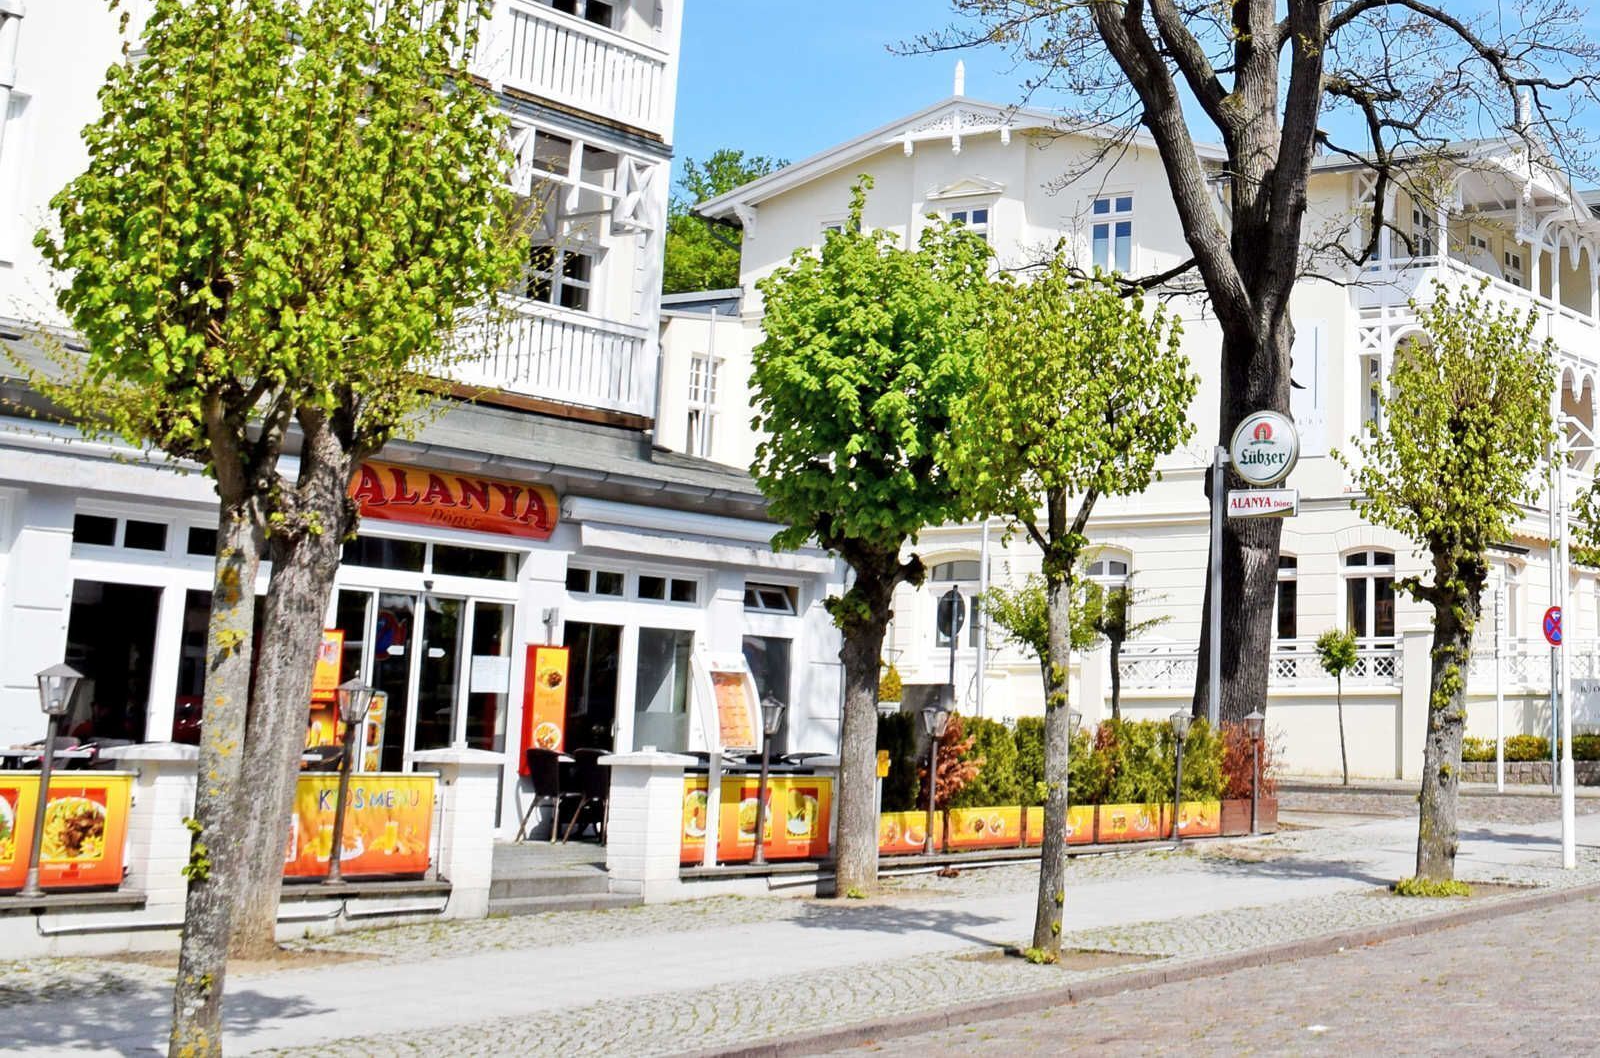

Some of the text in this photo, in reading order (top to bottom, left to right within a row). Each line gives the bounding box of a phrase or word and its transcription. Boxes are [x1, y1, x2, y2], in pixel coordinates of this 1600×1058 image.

[1240, 448, 1286, 466] Lübzer
[353, 463, 549, 531] ALANYA
[1231, 496, 1272, 509] ALANYA
